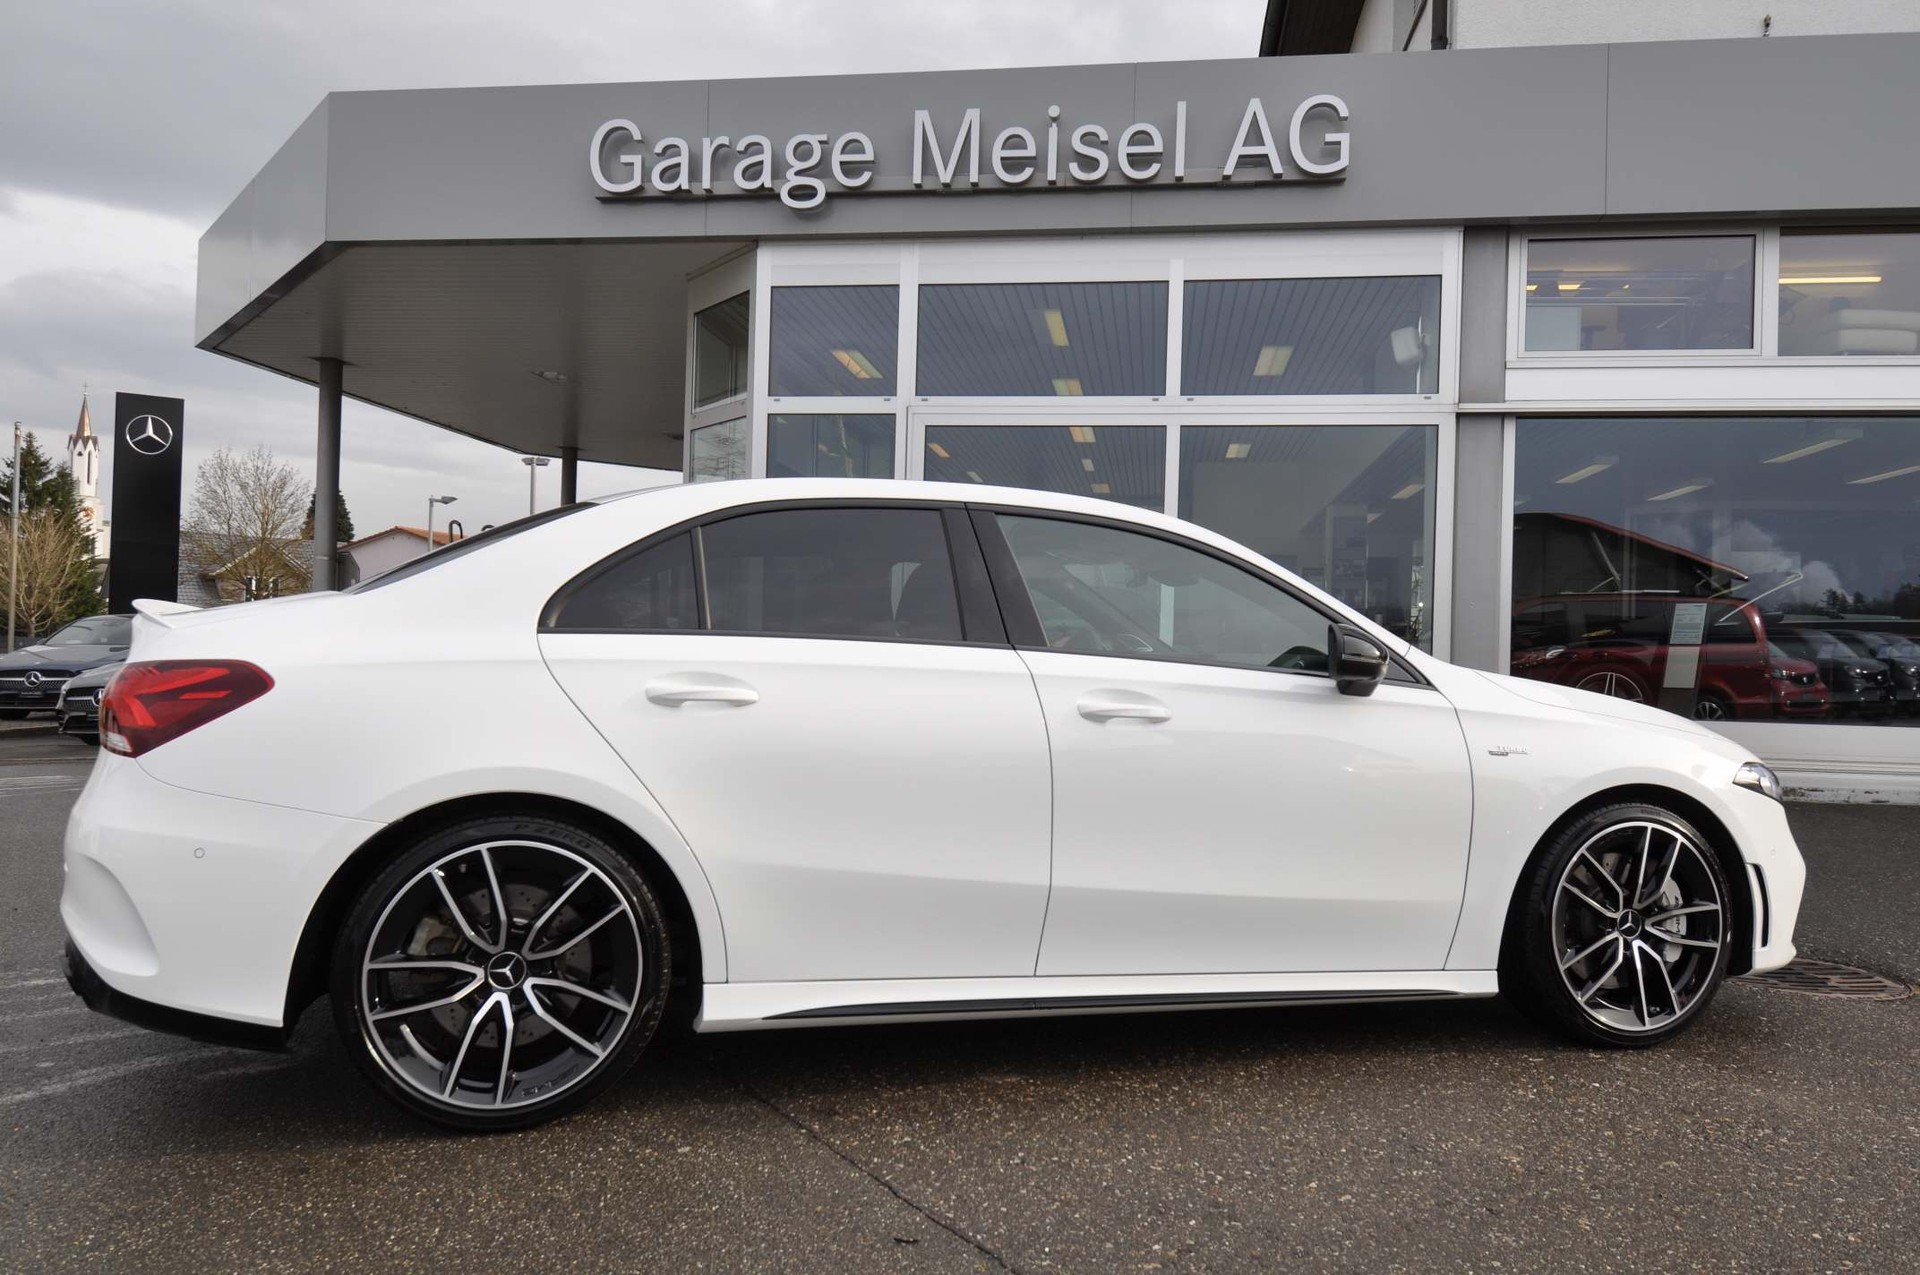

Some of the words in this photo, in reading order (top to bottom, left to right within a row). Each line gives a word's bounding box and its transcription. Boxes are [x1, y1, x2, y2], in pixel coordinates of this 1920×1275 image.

[590, 118, 877, 209] Garage
[912, 100, 1186, 188] Meisel
[1222, 94, 1350, 179] AG
